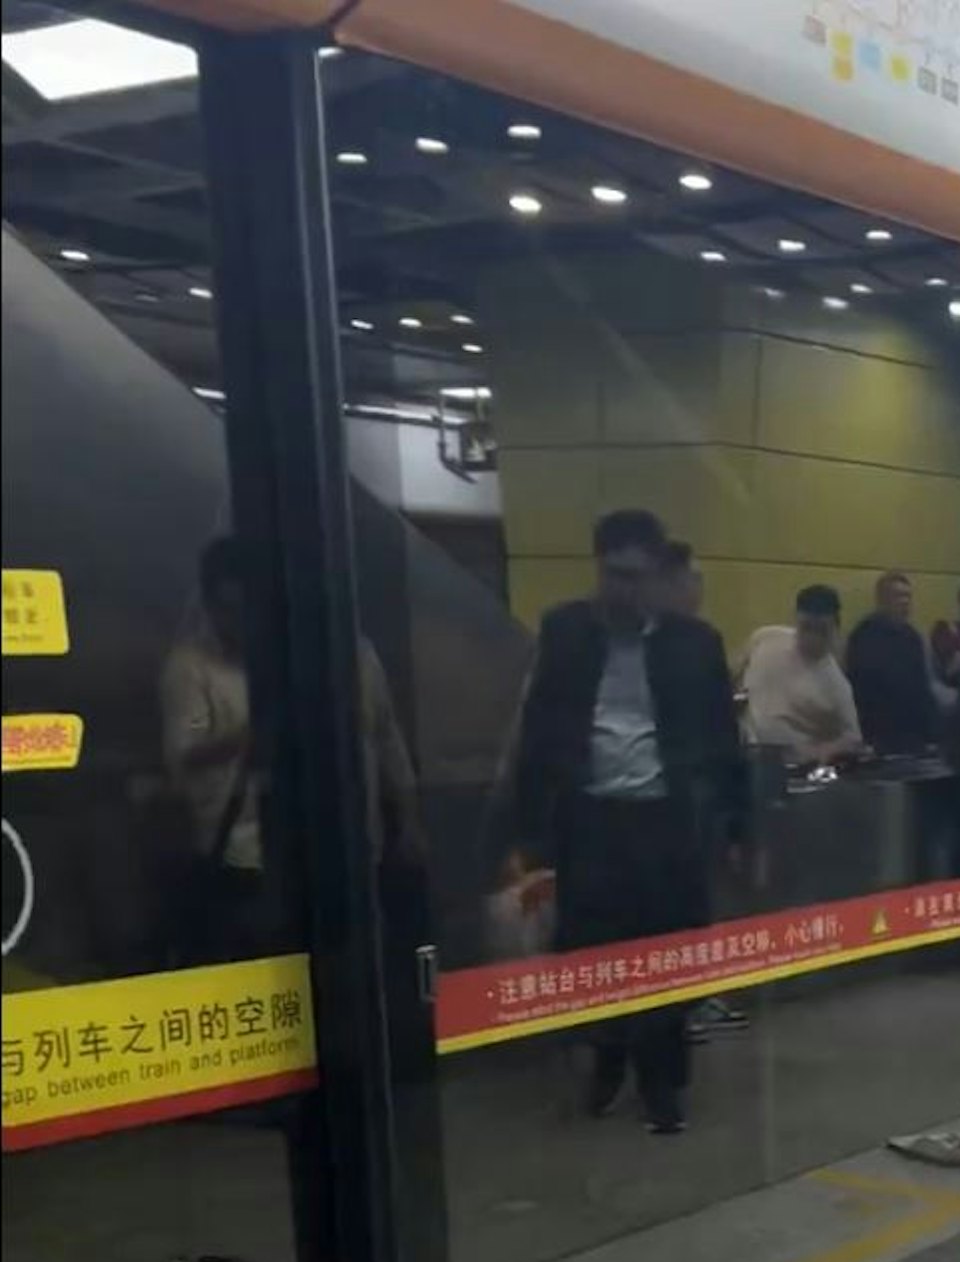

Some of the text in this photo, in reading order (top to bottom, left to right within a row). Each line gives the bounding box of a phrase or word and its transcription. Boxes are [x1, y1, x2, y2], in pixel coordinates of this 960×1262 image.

[2, 990, 303, 1077] 与列车之间的空隙
[48, 1068, 130, 1098] between
[139, 1056, 181, 1078] train
[190, 1047, 222, 1070] and
[229, 1034, 300, 1067] platform
